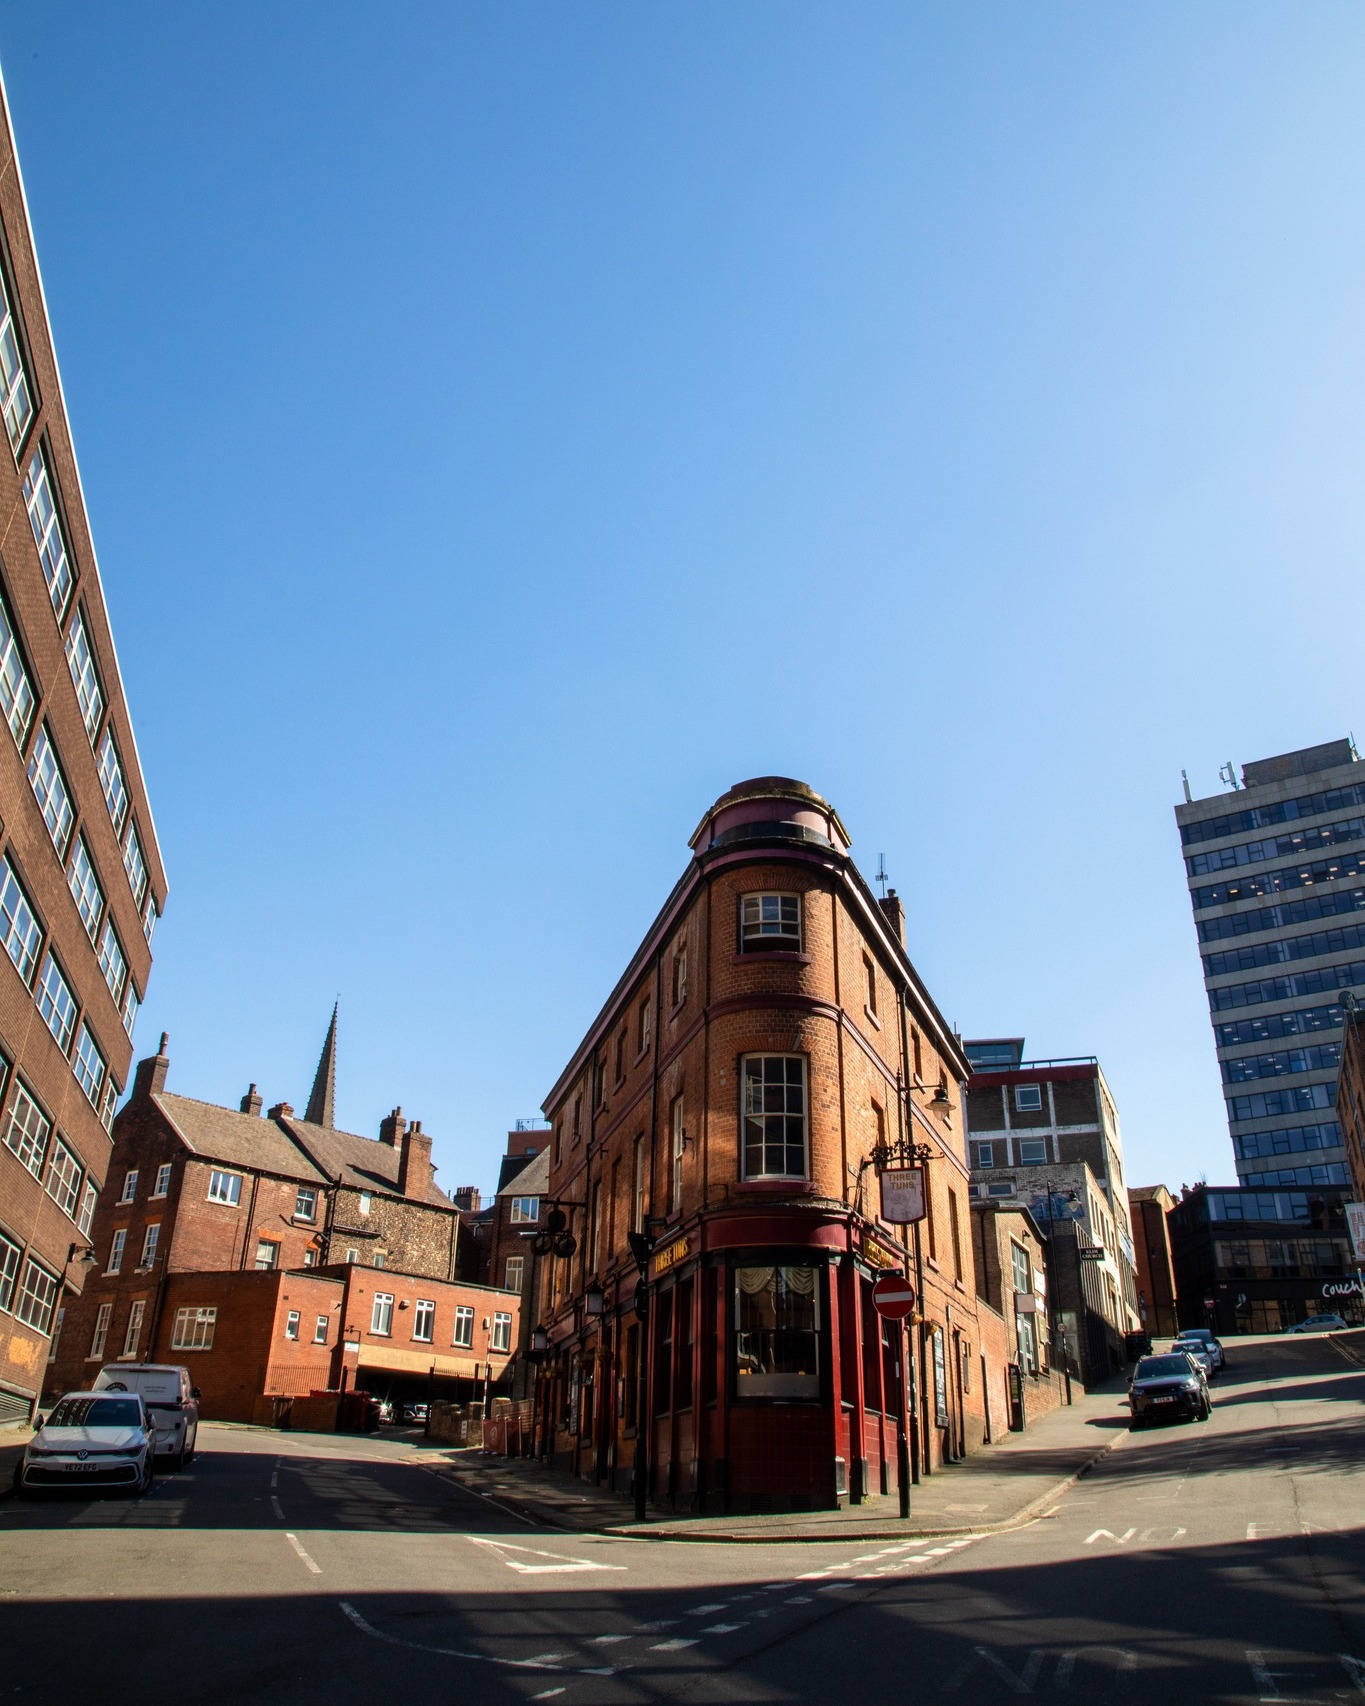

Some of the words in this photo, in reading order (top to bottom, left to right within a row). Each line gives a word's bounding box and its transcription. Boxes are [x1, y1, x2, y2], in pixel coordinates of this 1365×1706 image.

[888, 1173, 917, 1181] THREE
[890, 1181, 915, 1190] TUNS
[655, 1247, 672, 1272] THREE
[1084, 1527, 1187, 1543] NO
